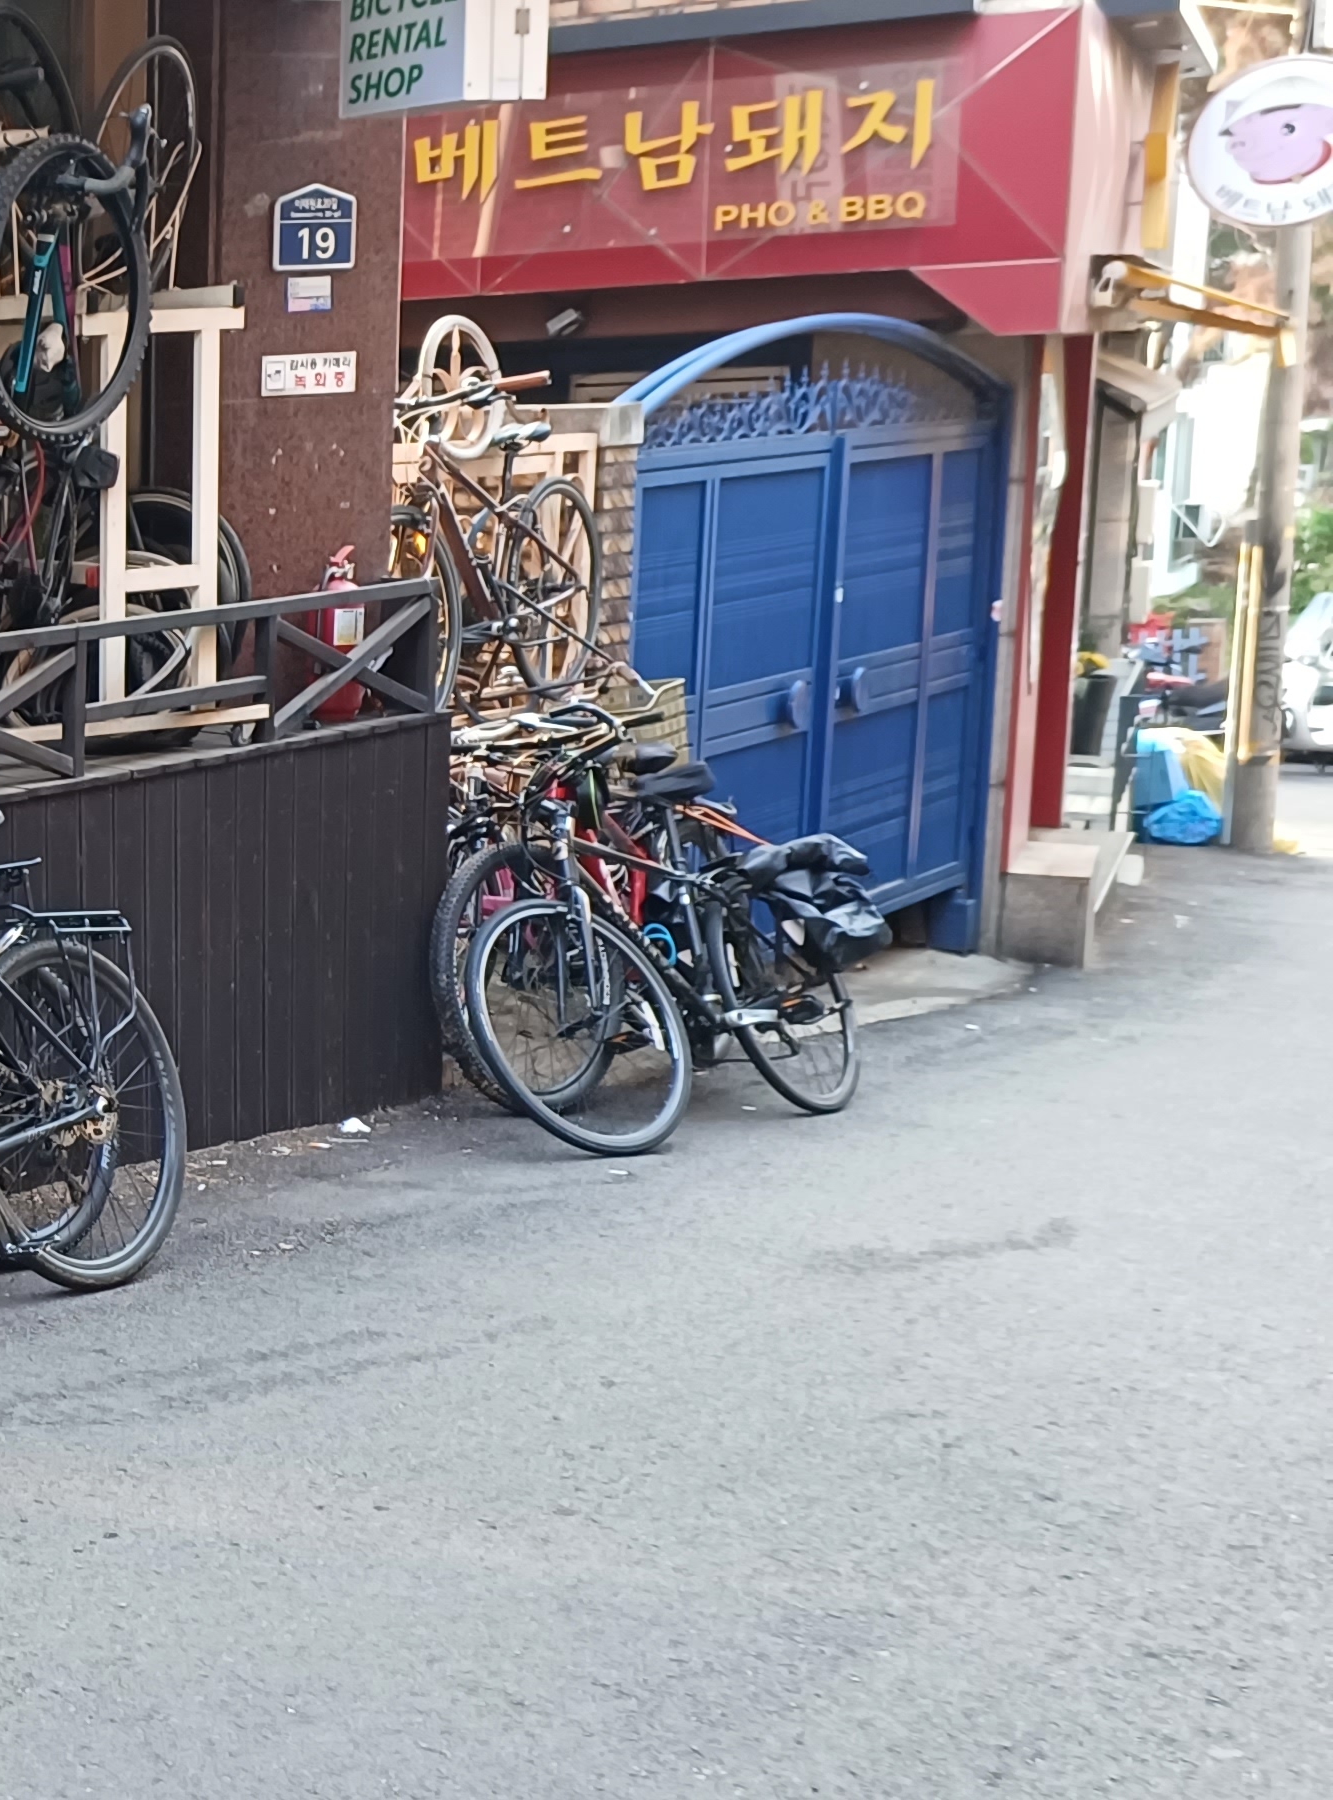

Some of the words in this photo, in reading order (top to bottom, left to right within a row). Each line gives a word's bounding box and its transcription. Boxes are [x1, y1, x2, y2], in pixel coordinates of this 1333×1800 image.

[349, 17, 447, 63] RENTAL
[348, 64, 424, 104] SHOP
[413, 78, 936, 203] 베트남돼지
[714, 201, 796, 232] PHO
[807, 199, 829, 226] &
[838, 191, 927, 225] BBQ
[297, 226, 336, 260] 19
